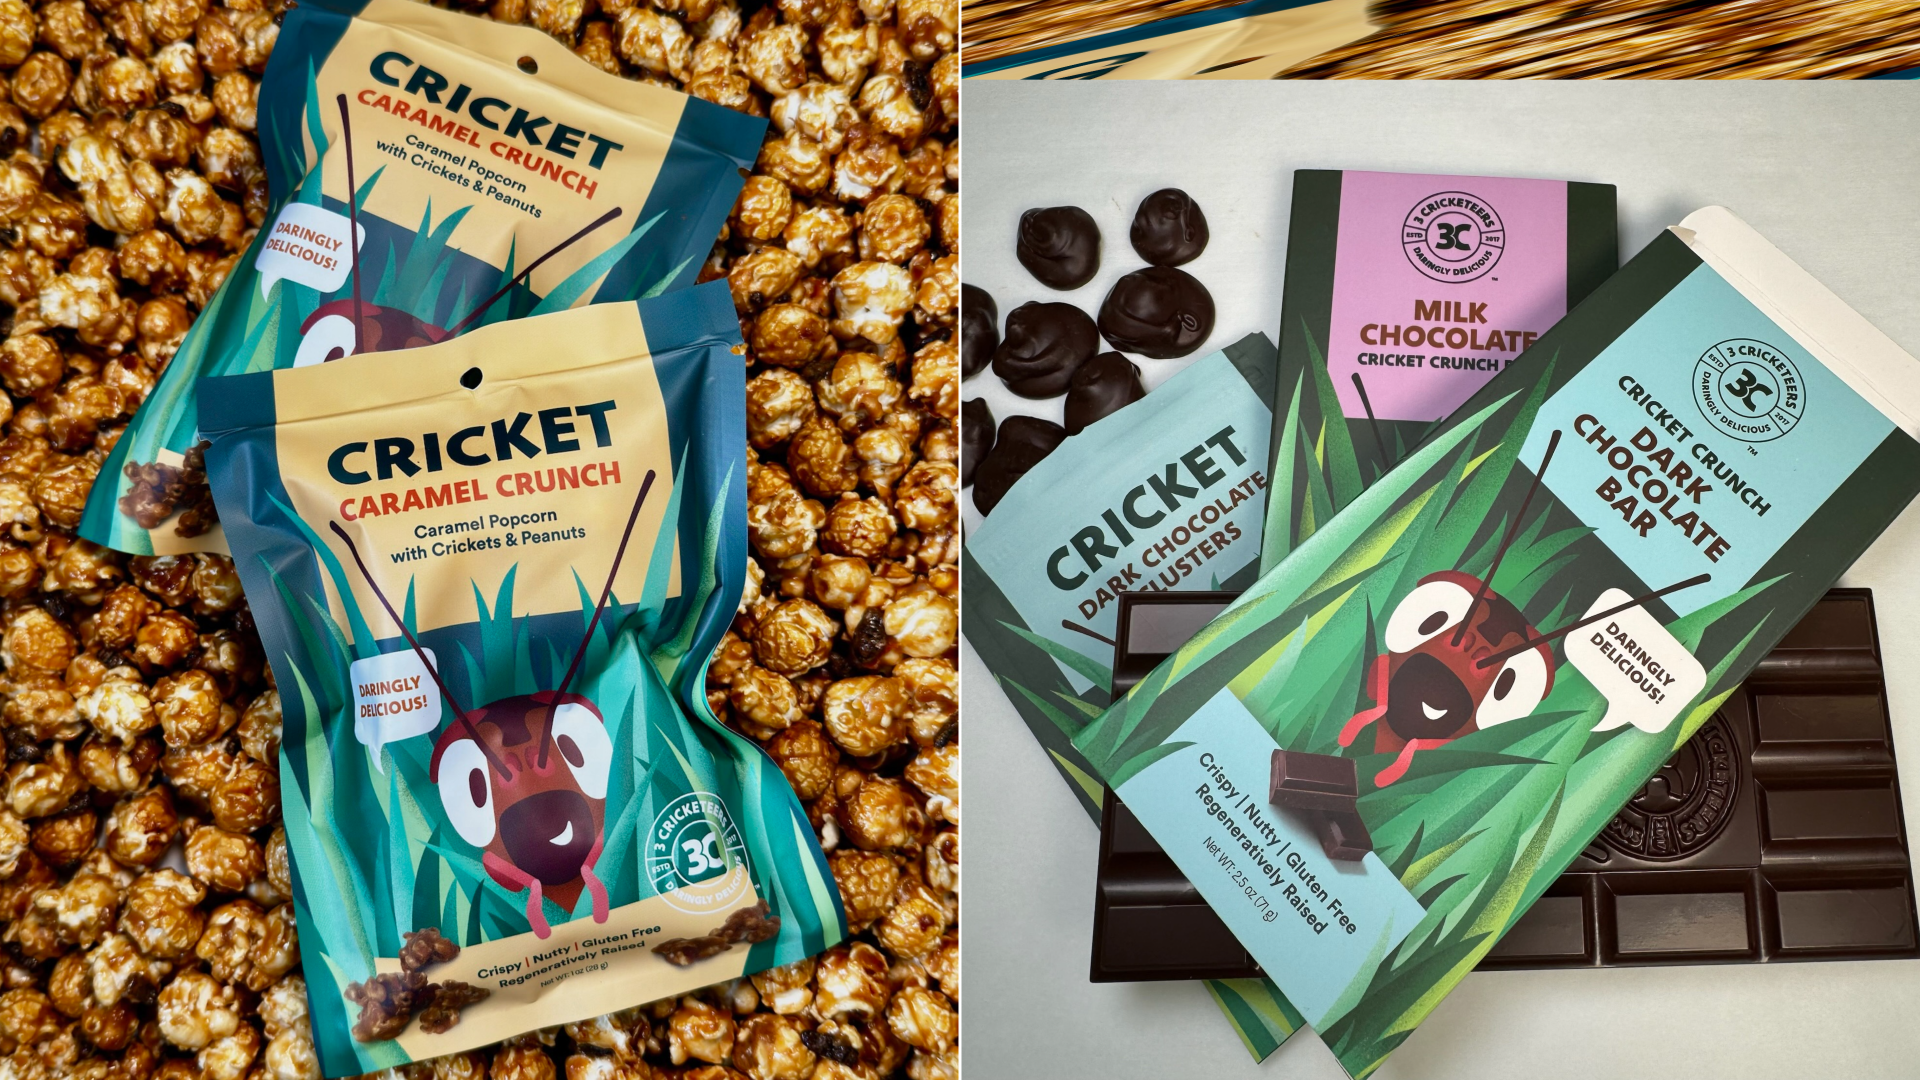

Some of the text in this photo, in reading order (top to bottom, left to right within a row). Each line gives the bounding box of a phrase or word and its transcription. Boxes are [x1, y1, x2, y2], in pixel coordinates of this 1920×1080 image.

[369, 51, 624, 171] CRICKET
[357, 89, 598, 200] CARAMEL CRUNCH
[405, 134, 527, 194] Caramel Popcorn
[376, 138, 543, 219] with Crickets & Peanuts
[275, 222, 343, 252] DARINGLY
[1414, 197, 1495, 228] 3 CRICKETEERS
[1435, 222, 1472, 251] 3C
[266, 238, 338, 271] DELICIOUS!
[1413, 246, 1493, 276] DARINGLY DELICIOUS
[1414, 299, 1488, 325] MILK
[1357, 352, 1425, 368] CRICKET
[1430, 356, 1498, 371] CRUNCH
[1707, 353, 1724, 368] ESTD
[1726, 345, 1798, 410] 3 CRICKETEERS
[1701, 371, 1772, 434] DARINGLY DELICIOUS
[1725, 368, 1774, 413] 3C
[327, 399, 617, 485] CRICKET
[1774, 411, 1790, 427] 2017
[1618, 375, 1772, 517] CRICKET CRUNCH
[1629, 426, 1713, 505] DARK
[339, 461, 621, 522] CARAMEL CRUNCH
[1046, 424, 1247, 591] CRICKET
[1573, 413, 1732, 564] CHOCOLATE
[1595, 475, 1657, 538] BAR
[391, 526, 586, 564] with Crickets & Peanuts
[414, 510, 558, 539] Caramel Popcorn
[1078, 470, 1267, 621] DARK CHOCOLATE
[1590, 632, 1666, 705] DELICIOUS!
[1605, 621, 1676, 687] DARINGLY
[358, 675, 421, 698] DARINGLY
[360, 694, 428, 718] DELICIOUS!
[654, 800, 728, 852] 3 CRICKETEERS
[1199, 752, 1240, 800] Crispy
[1243, 802, 1281, 848] Nutty
[1286, 852, 1329, 903] Gluten
[1326, 898, 1357, 935] Free
[651, 862, 671, 874] ESTD
[681, 831, 724, 876] 3C
[1195, 783, 1329, 935] Regeneratively Raised
[1202, 836, 1221, 859] Net
[1217, 852, 1236, 875] WT:
[1231, 870, 1249, 889] 2.5
[1244, 886, 1258, 901] oz
[1262, 910, 1279, 923] g)
[665, 855, 742, 906] DARINGLY DELICIOUS
[477, 961, 522, 979] Crispy
[532, 944, 571, 964] Nutty
[582, 932, 628, 949] Gluten
[632, 925, 661, 938] Free
[499, 940, 645, 988] Regeneratively Raised
[540, 978, 554, 988] Net
